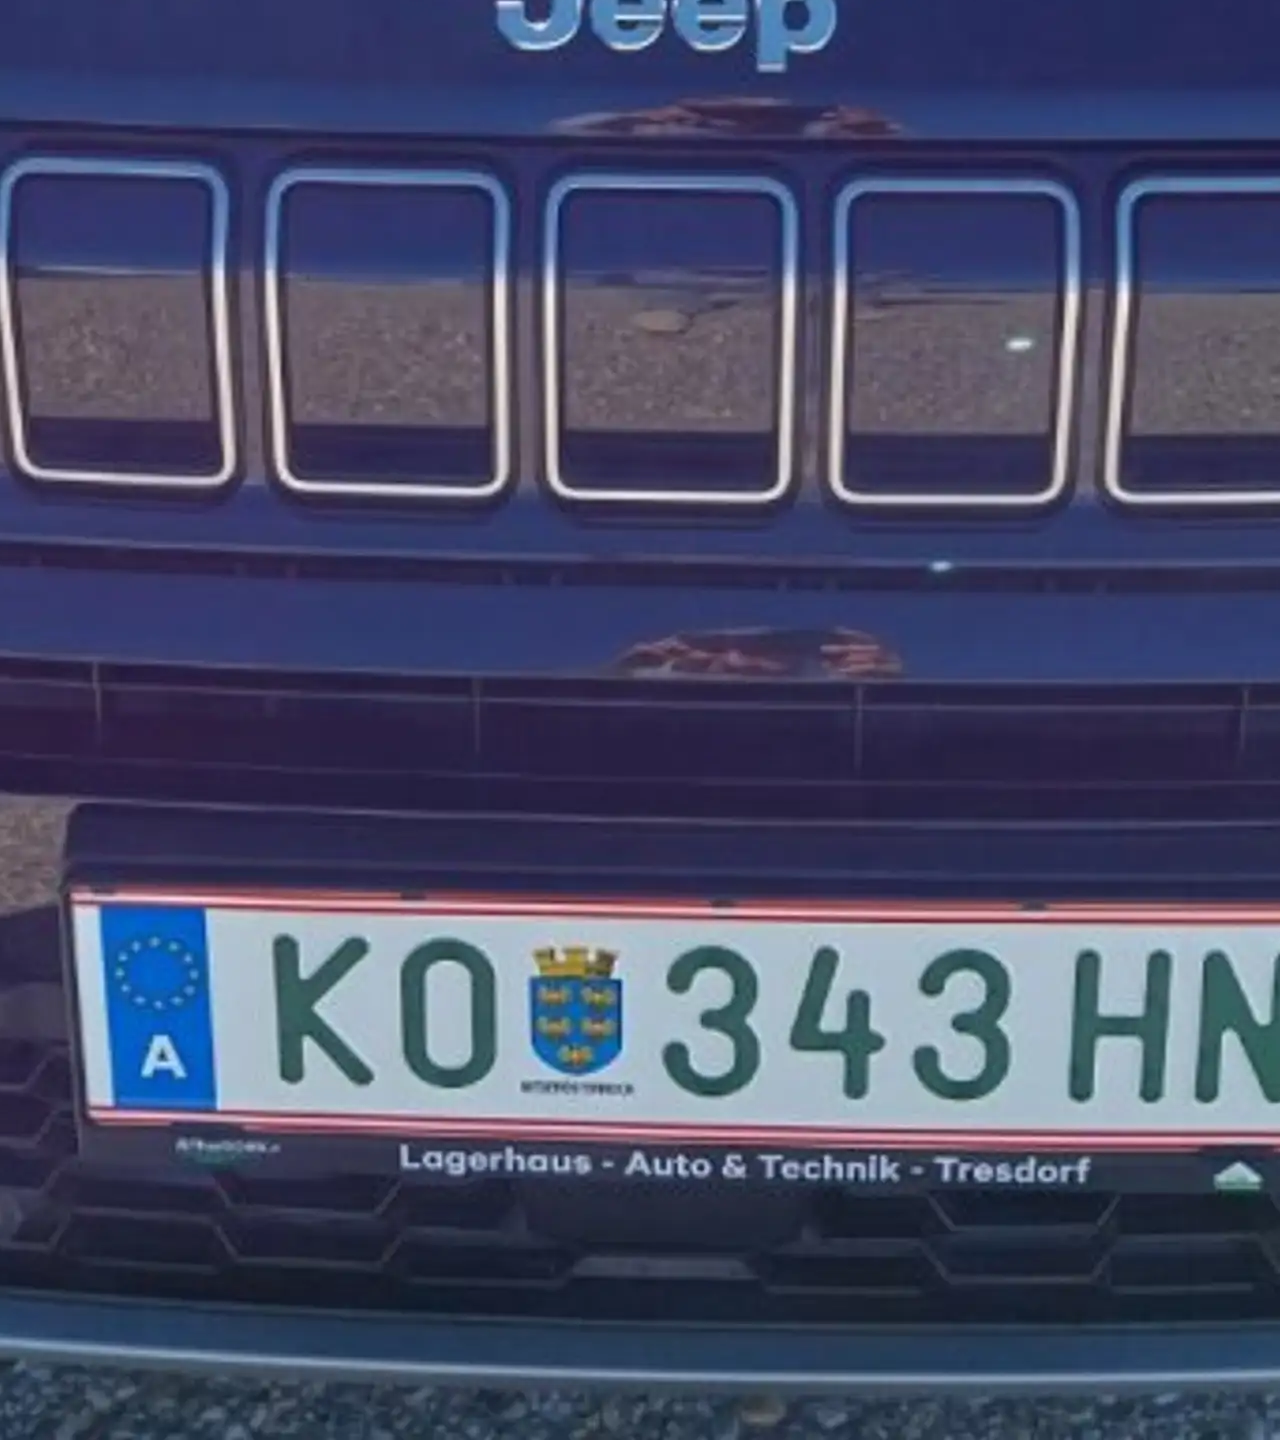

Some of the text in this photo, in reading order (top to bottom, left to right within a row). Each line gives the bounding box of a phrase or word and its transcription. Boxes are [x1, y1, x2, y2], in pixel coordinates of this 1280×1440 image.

[272, 932, 498, 1089] KO
[661, 945, 1012, 1101] 343
[140, 1034, 188, 1079] A
[398, 1143, 593, 1177] Lagerhaus
[624, 1150, 713, 1178] Auto
[721, 1153, 747, 1179] &
[757, 1154, 901, 1182] Technik
[932, 1155, 1092, 1185] Tresdorf
